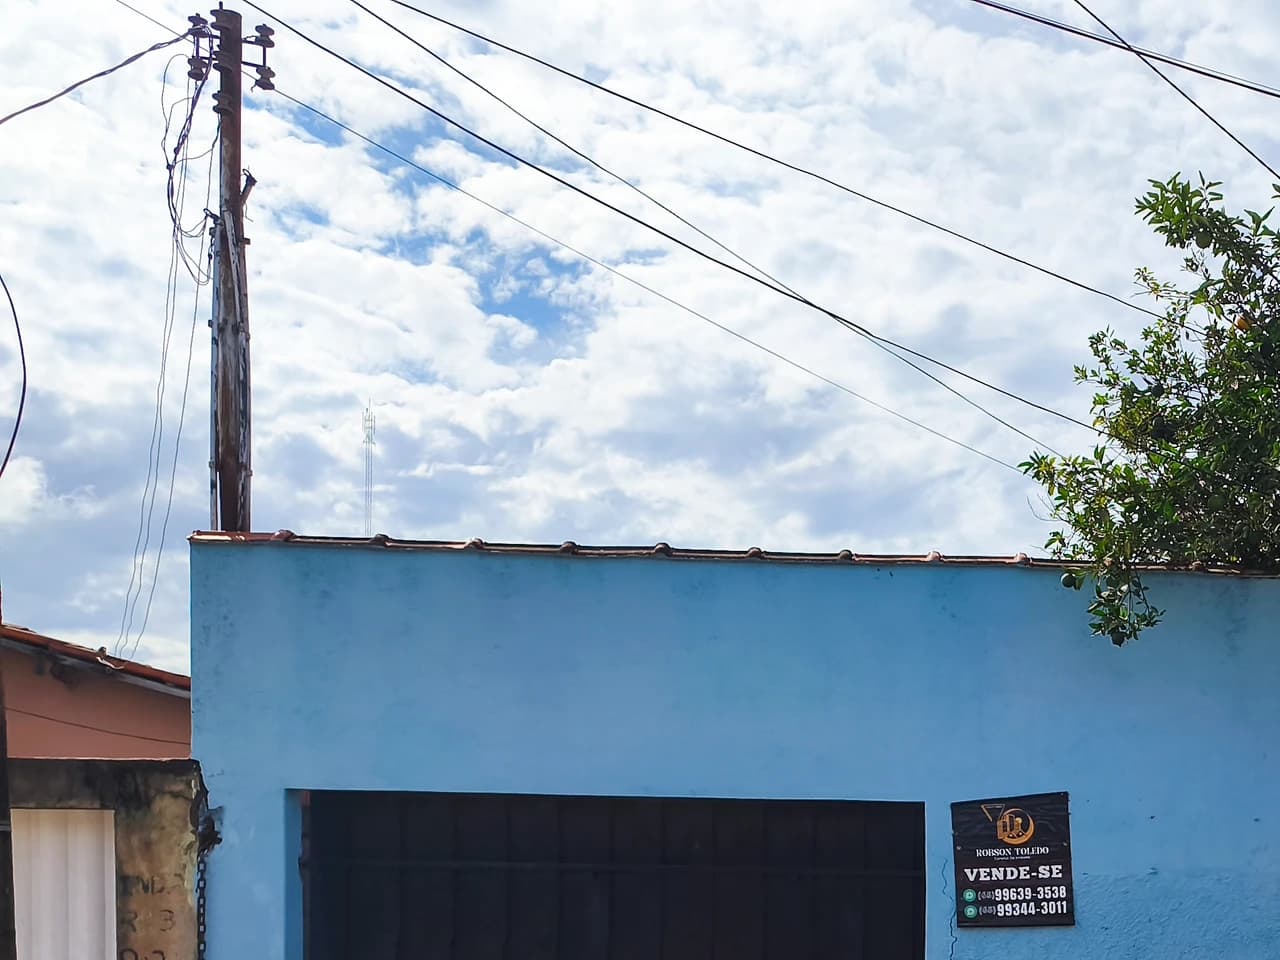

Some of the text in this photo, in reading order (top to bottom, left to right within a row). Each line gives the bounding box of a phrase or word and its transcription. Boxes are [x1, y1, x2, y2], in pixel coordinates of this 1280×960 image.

[976, 846, 1049, 857] ROBSON TOLEDO
[964, 865, 1063, 881] VENDE-SE
